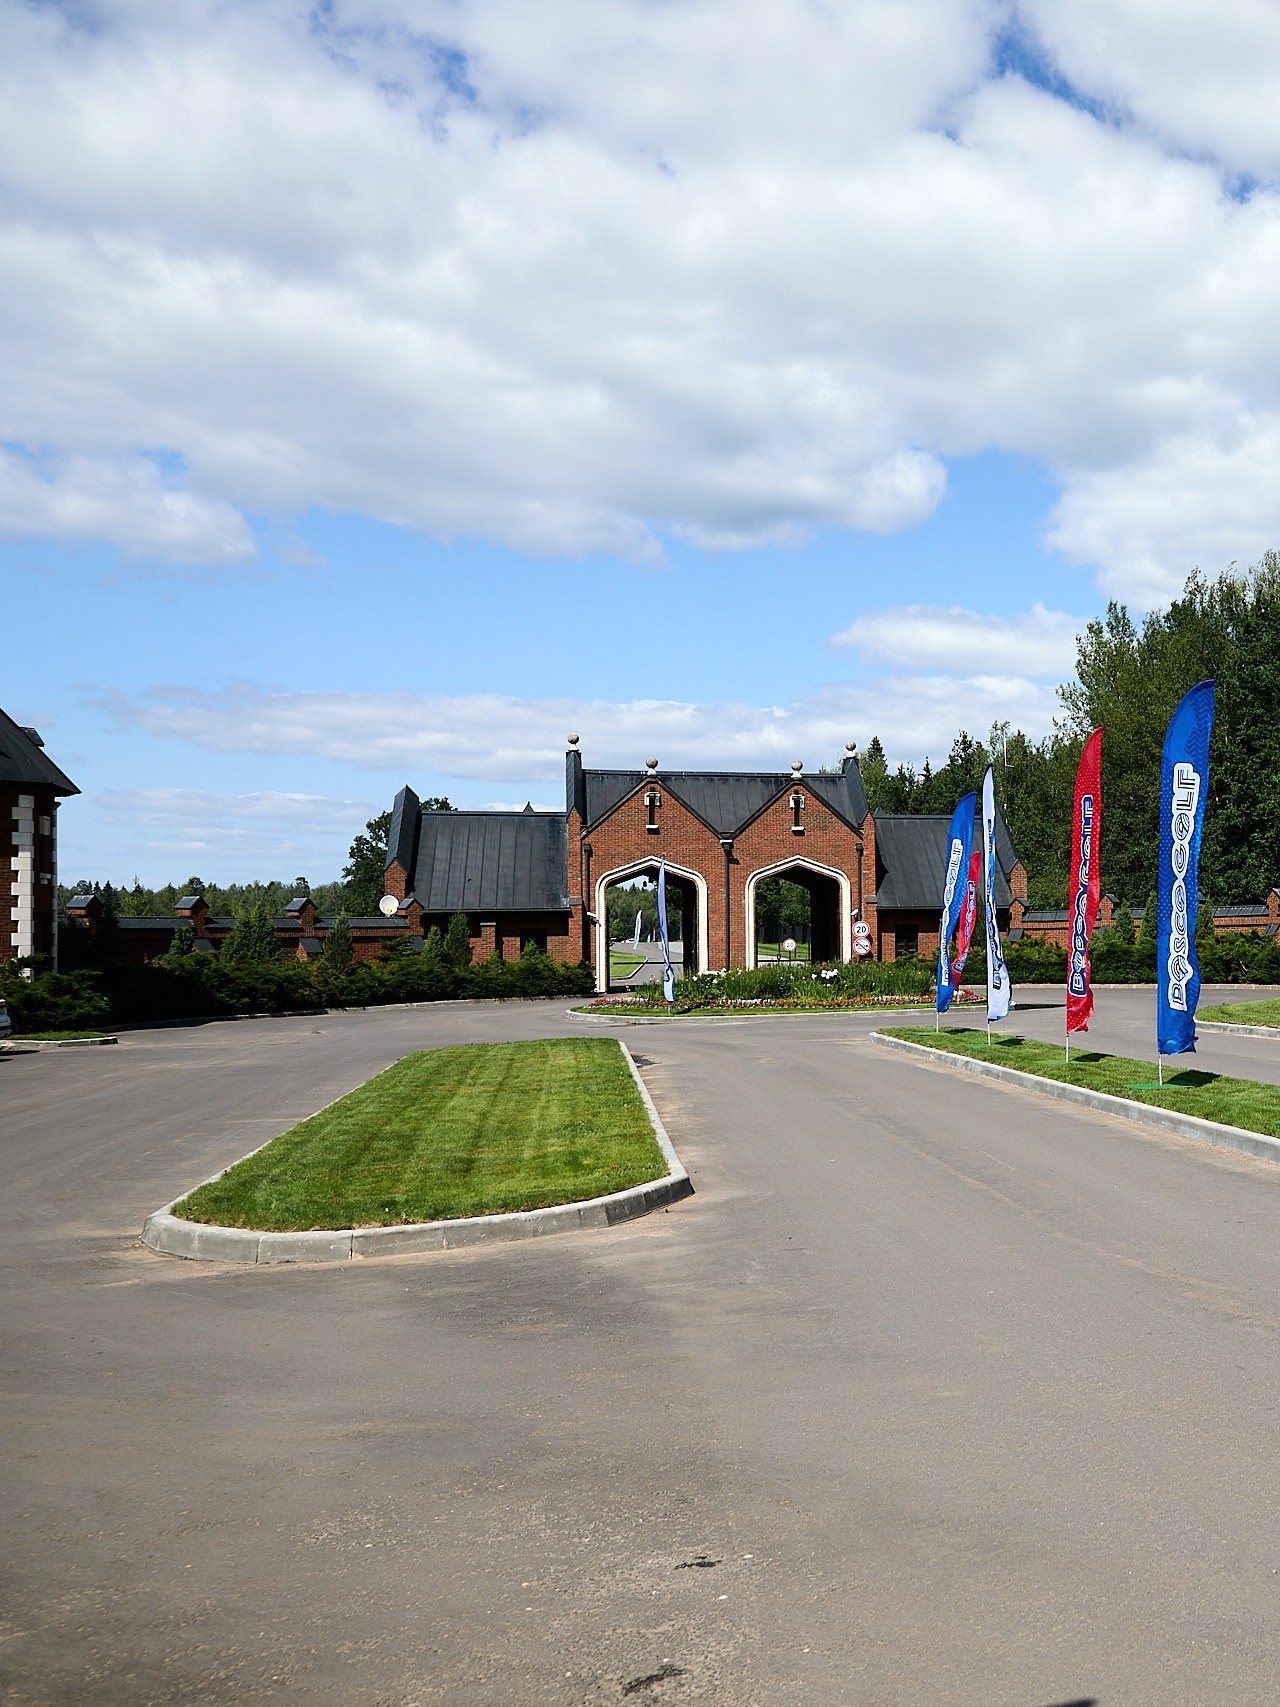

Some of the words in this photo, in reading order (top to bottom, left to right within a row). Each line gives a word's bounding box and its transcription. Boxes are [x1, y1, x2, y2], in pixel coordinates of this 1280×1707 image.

[1172, 767, 1198, 870] GOLF
[856, 926, 867, 934] 20
[1170, 884, 1191, 1005] BOSCO
